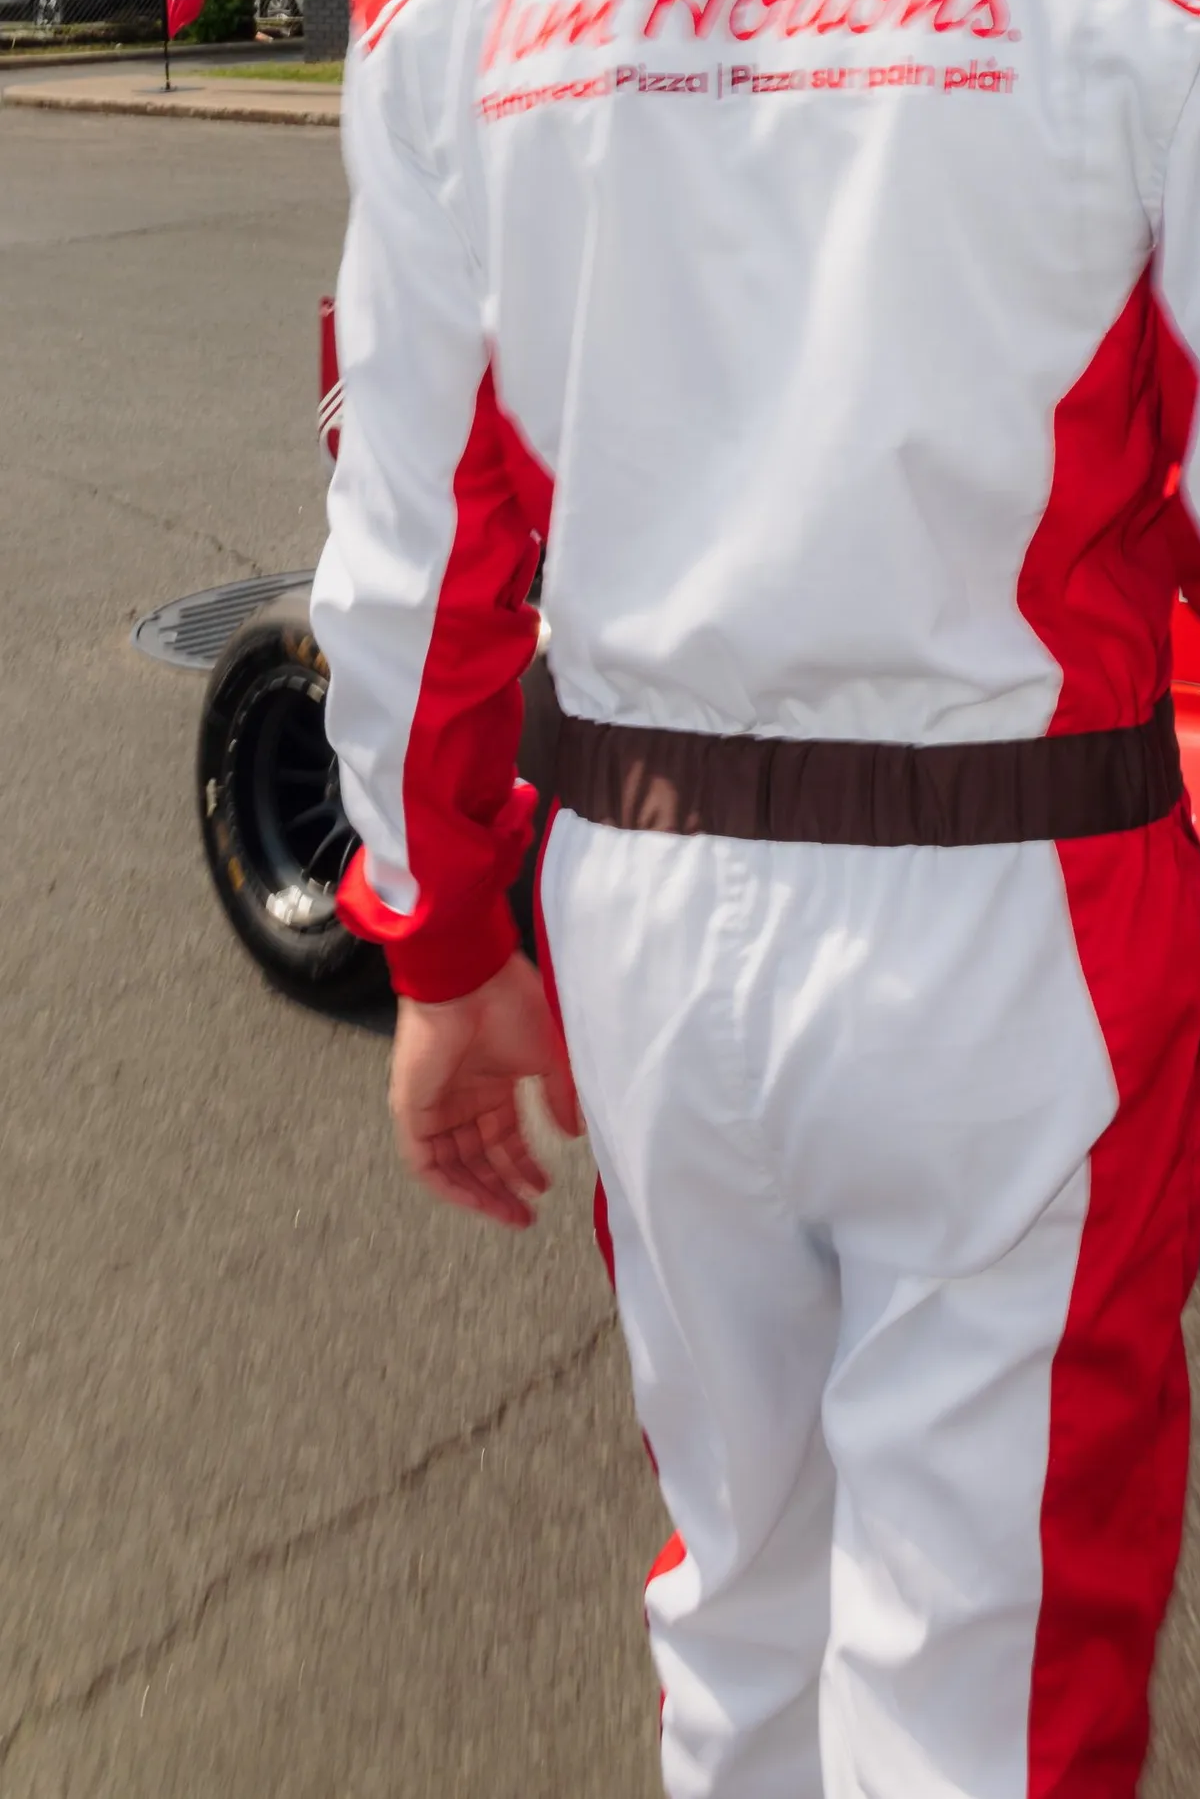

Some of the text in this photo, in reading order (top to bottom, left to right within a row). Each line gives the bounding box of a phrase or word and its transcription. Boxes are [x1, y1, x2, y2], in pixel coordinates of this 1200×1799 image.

[615, 63, 709, 94] Pizza
[730, 63, 805, 94] Pizza
[867, 55, 936, 91] pain
